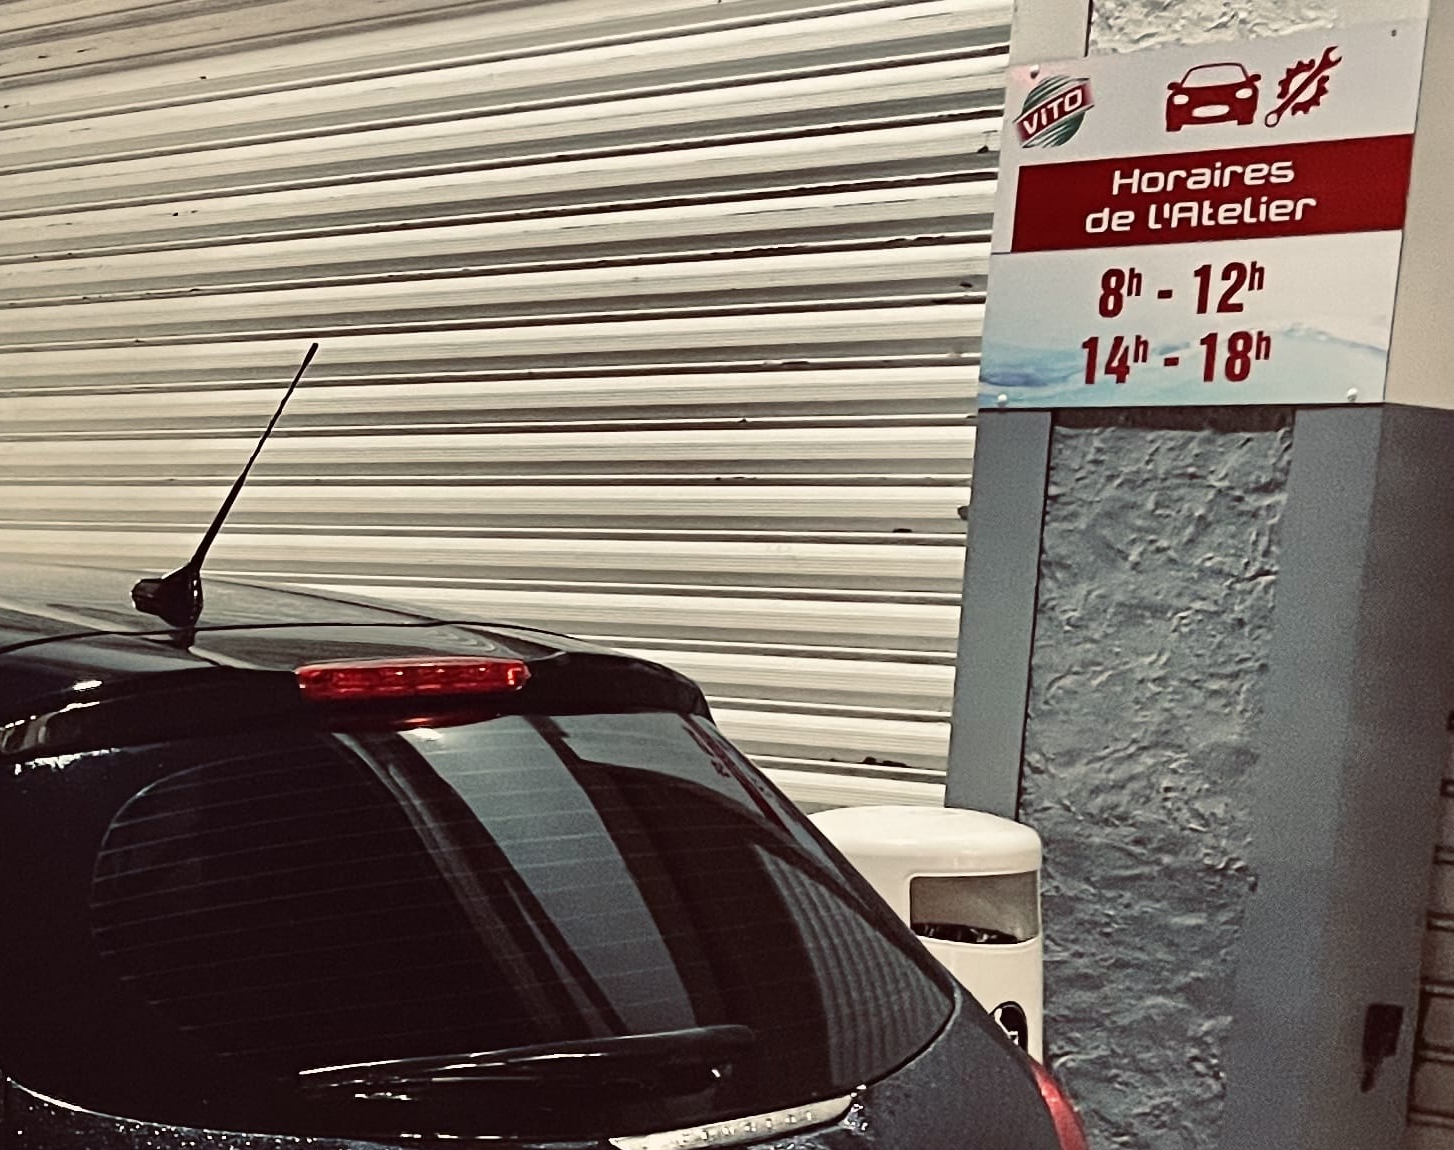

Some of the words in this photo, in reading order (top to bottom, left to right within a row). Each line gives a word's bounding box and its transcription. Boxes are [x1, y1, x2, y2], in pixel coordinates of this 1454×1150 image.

[1022, 88, 1083, 135] VITO
[1112, 161, 1295, 195] Horaires
[1085, 208, 1135, 233] de
[1148, 196, 1317, 230] l'Atelier
[1098, 267, 1143, 318] 8h
[1157, 289, 1173, 299] -
[1193, 261, 1265, 315] 12h
[1081, 335, 1149, 384] 14h
[1164, 357, 1179, 367] -
[1198, 330, 1272, 383] 18h
